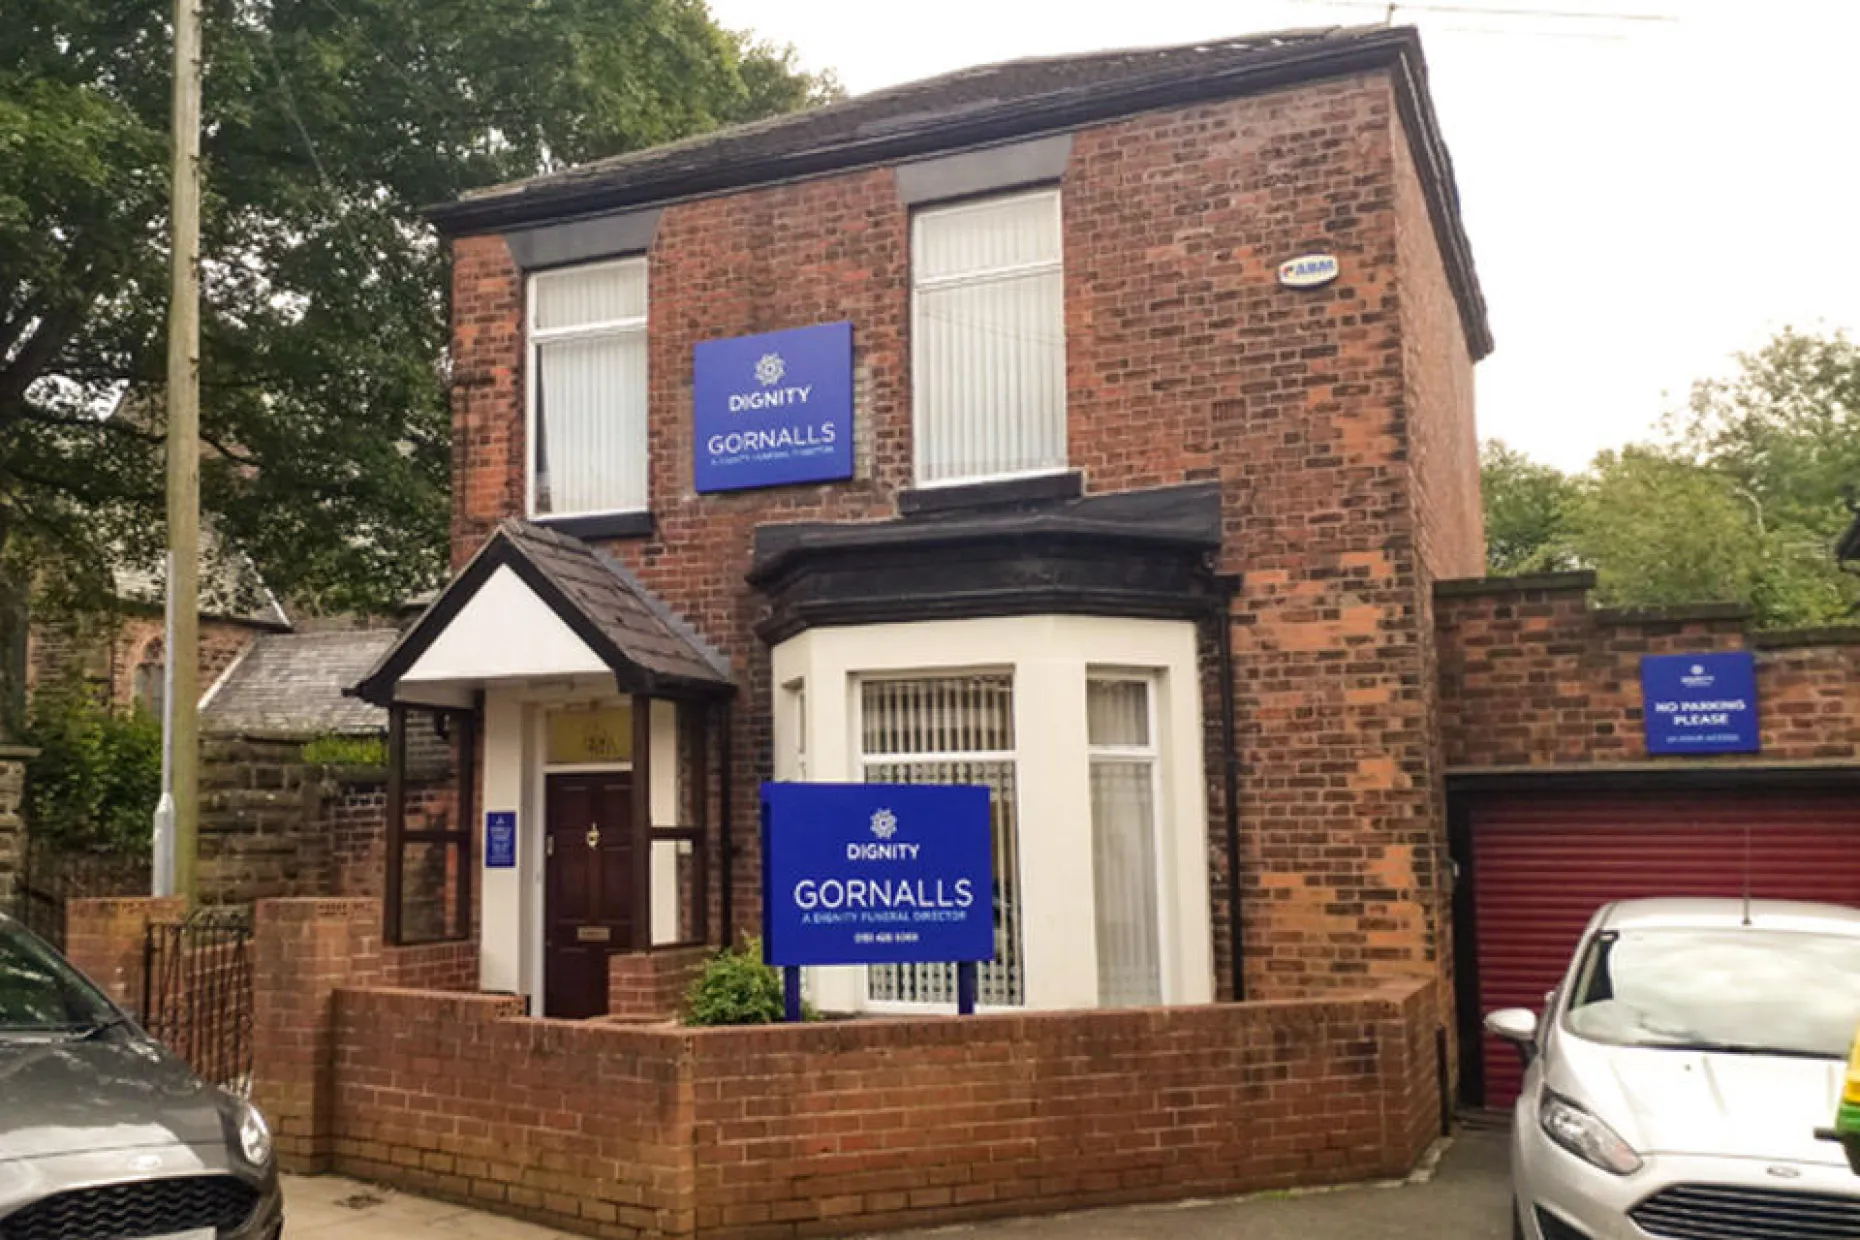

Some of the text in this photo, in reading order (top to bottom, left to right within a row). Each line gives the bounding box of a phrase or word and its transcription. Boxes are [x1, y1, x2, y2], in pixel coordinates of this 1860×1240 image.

[729, 384, 812, 412] DIGNITY
[708, 422, 836, 455] GORNALLS
[1655, 699, 1746, 713] NO PARKING
[1673, 713, 1729, 726] PLEASE
[846, 843, 920, 860] DIGNITY
[793, 879, 974, 909] GORNALLS
[813, 912, 857, 924] DIGNITY
[862, 911, 910, 923] FUNERAL
[913, 910, 967, 922] DIRECTOR
